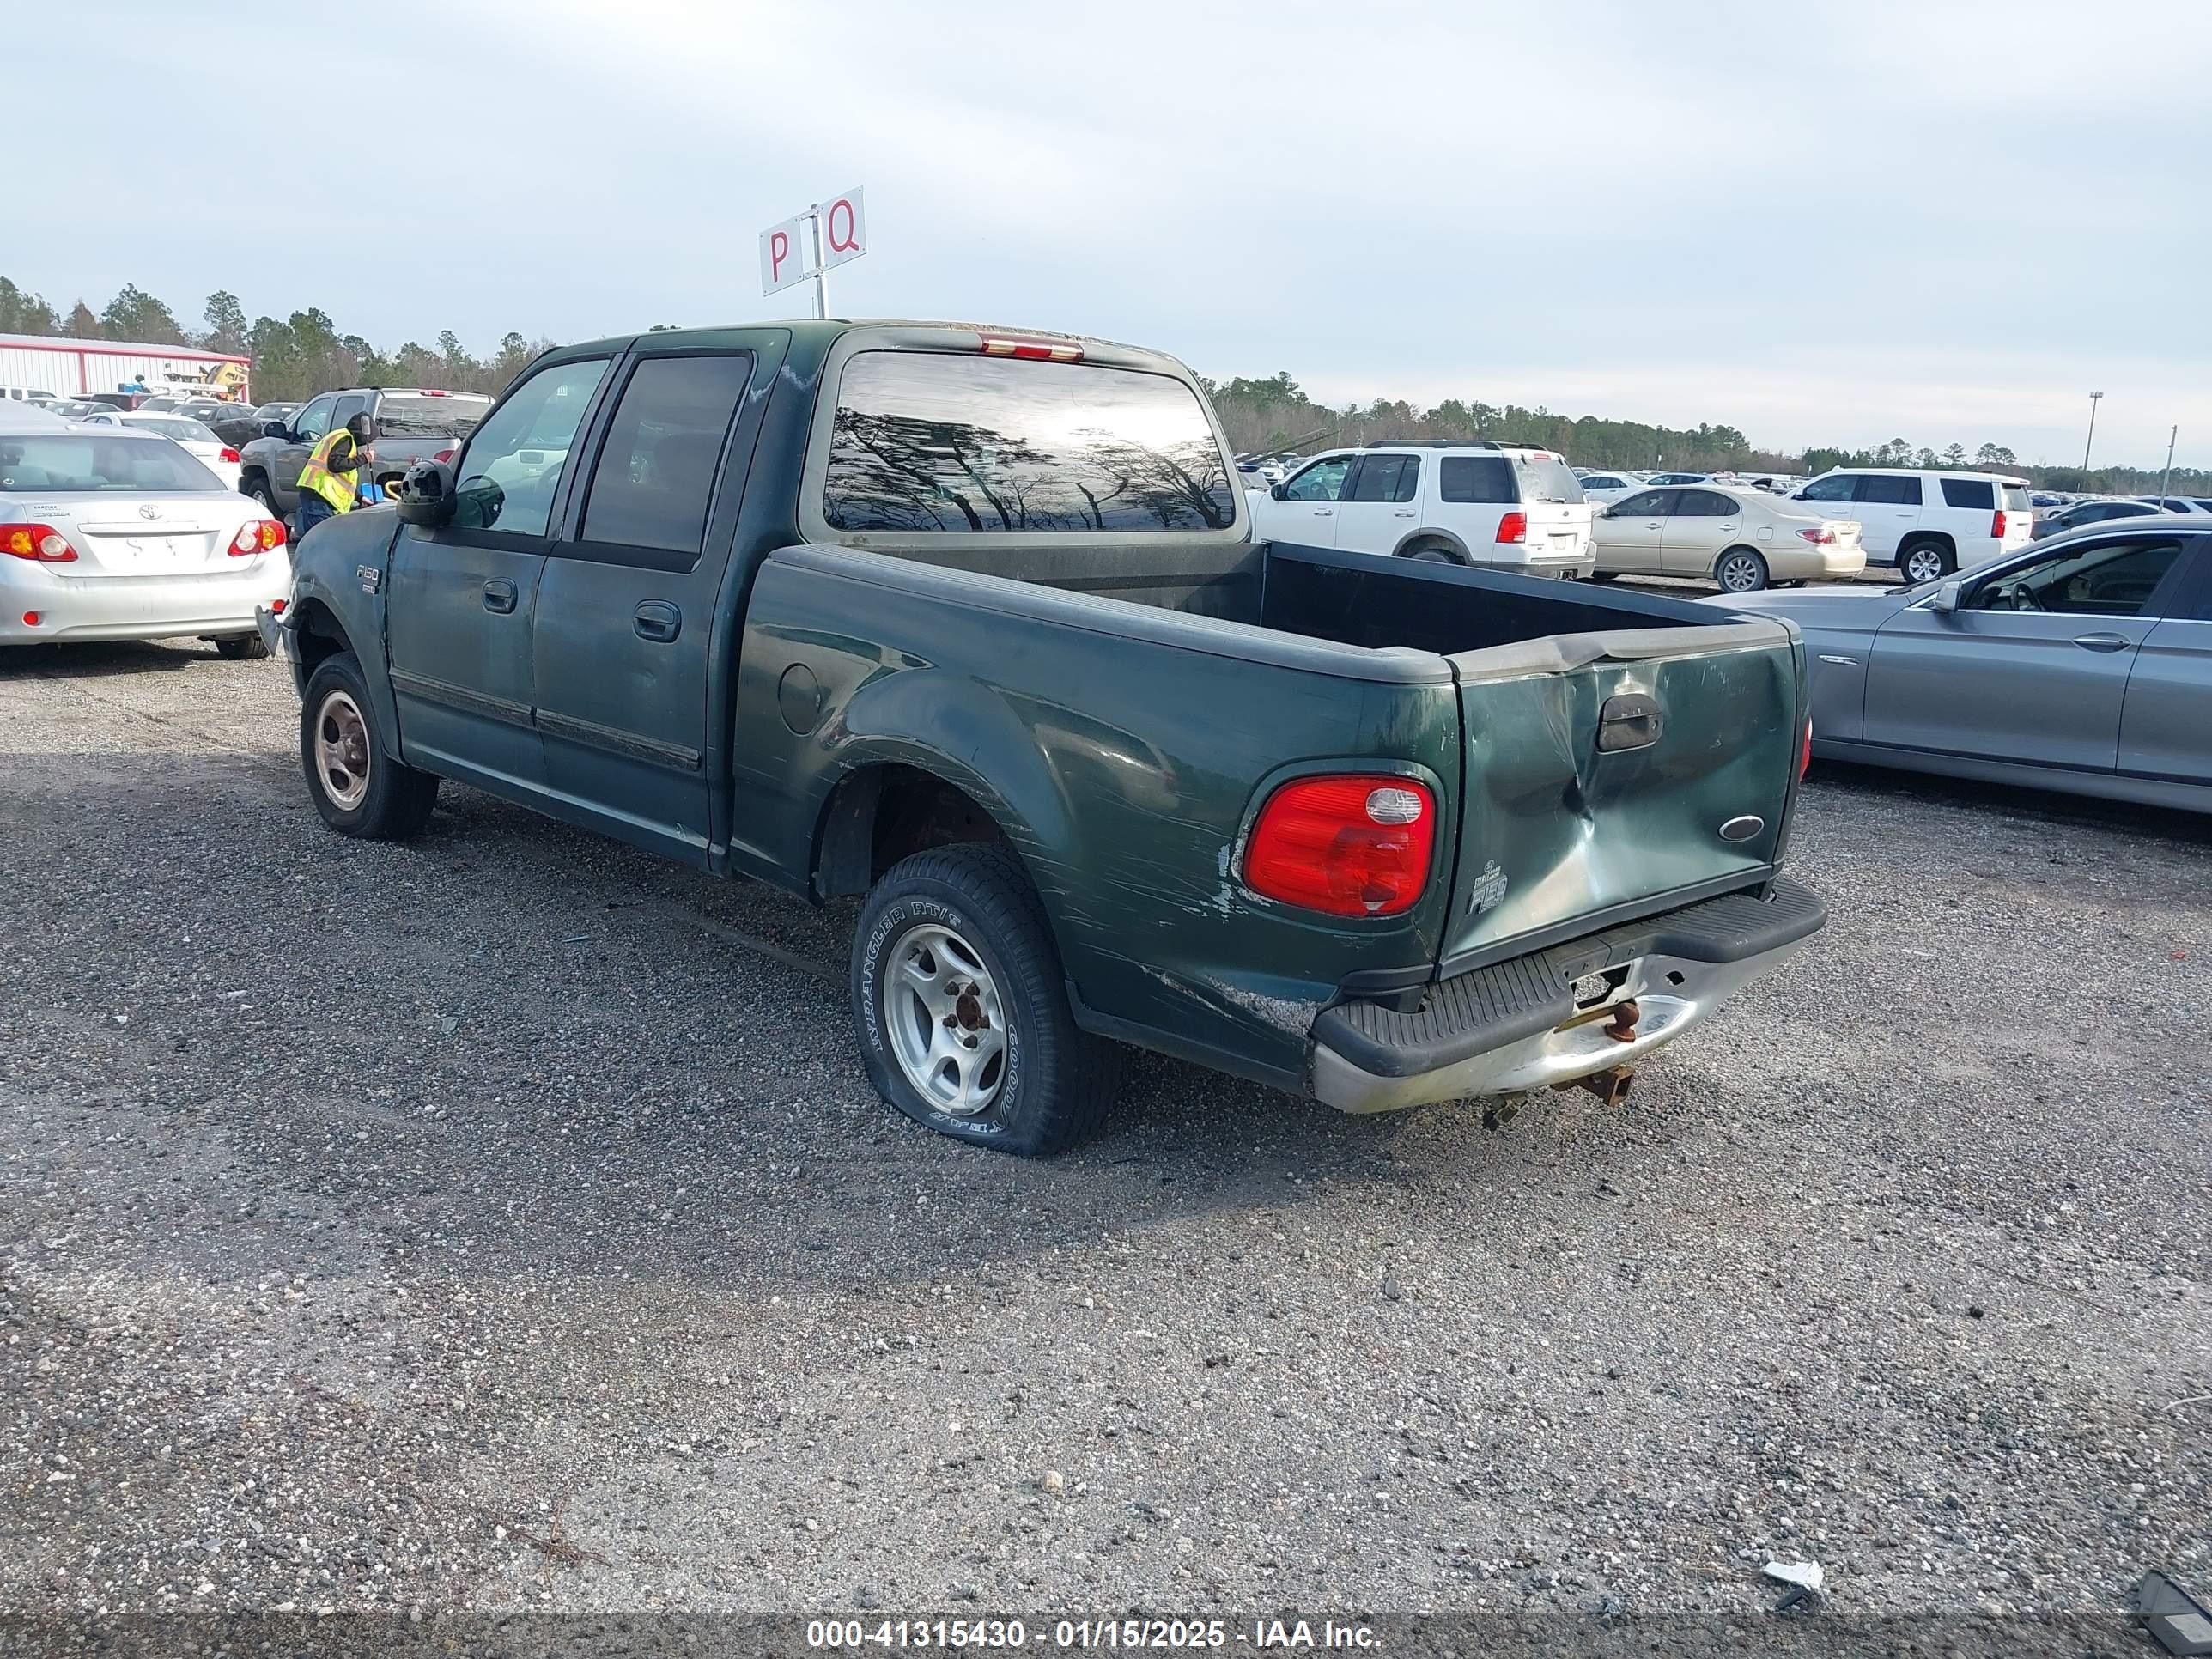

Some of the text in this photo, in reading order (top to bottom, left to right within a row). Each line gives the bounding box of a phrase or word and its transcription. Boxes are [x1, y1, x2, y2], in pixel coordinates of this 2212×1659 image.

[828, 199, 860, 252] Q
[770, 231, 788, 283] P
[862, 906, 906, 1052] WRANGLER
